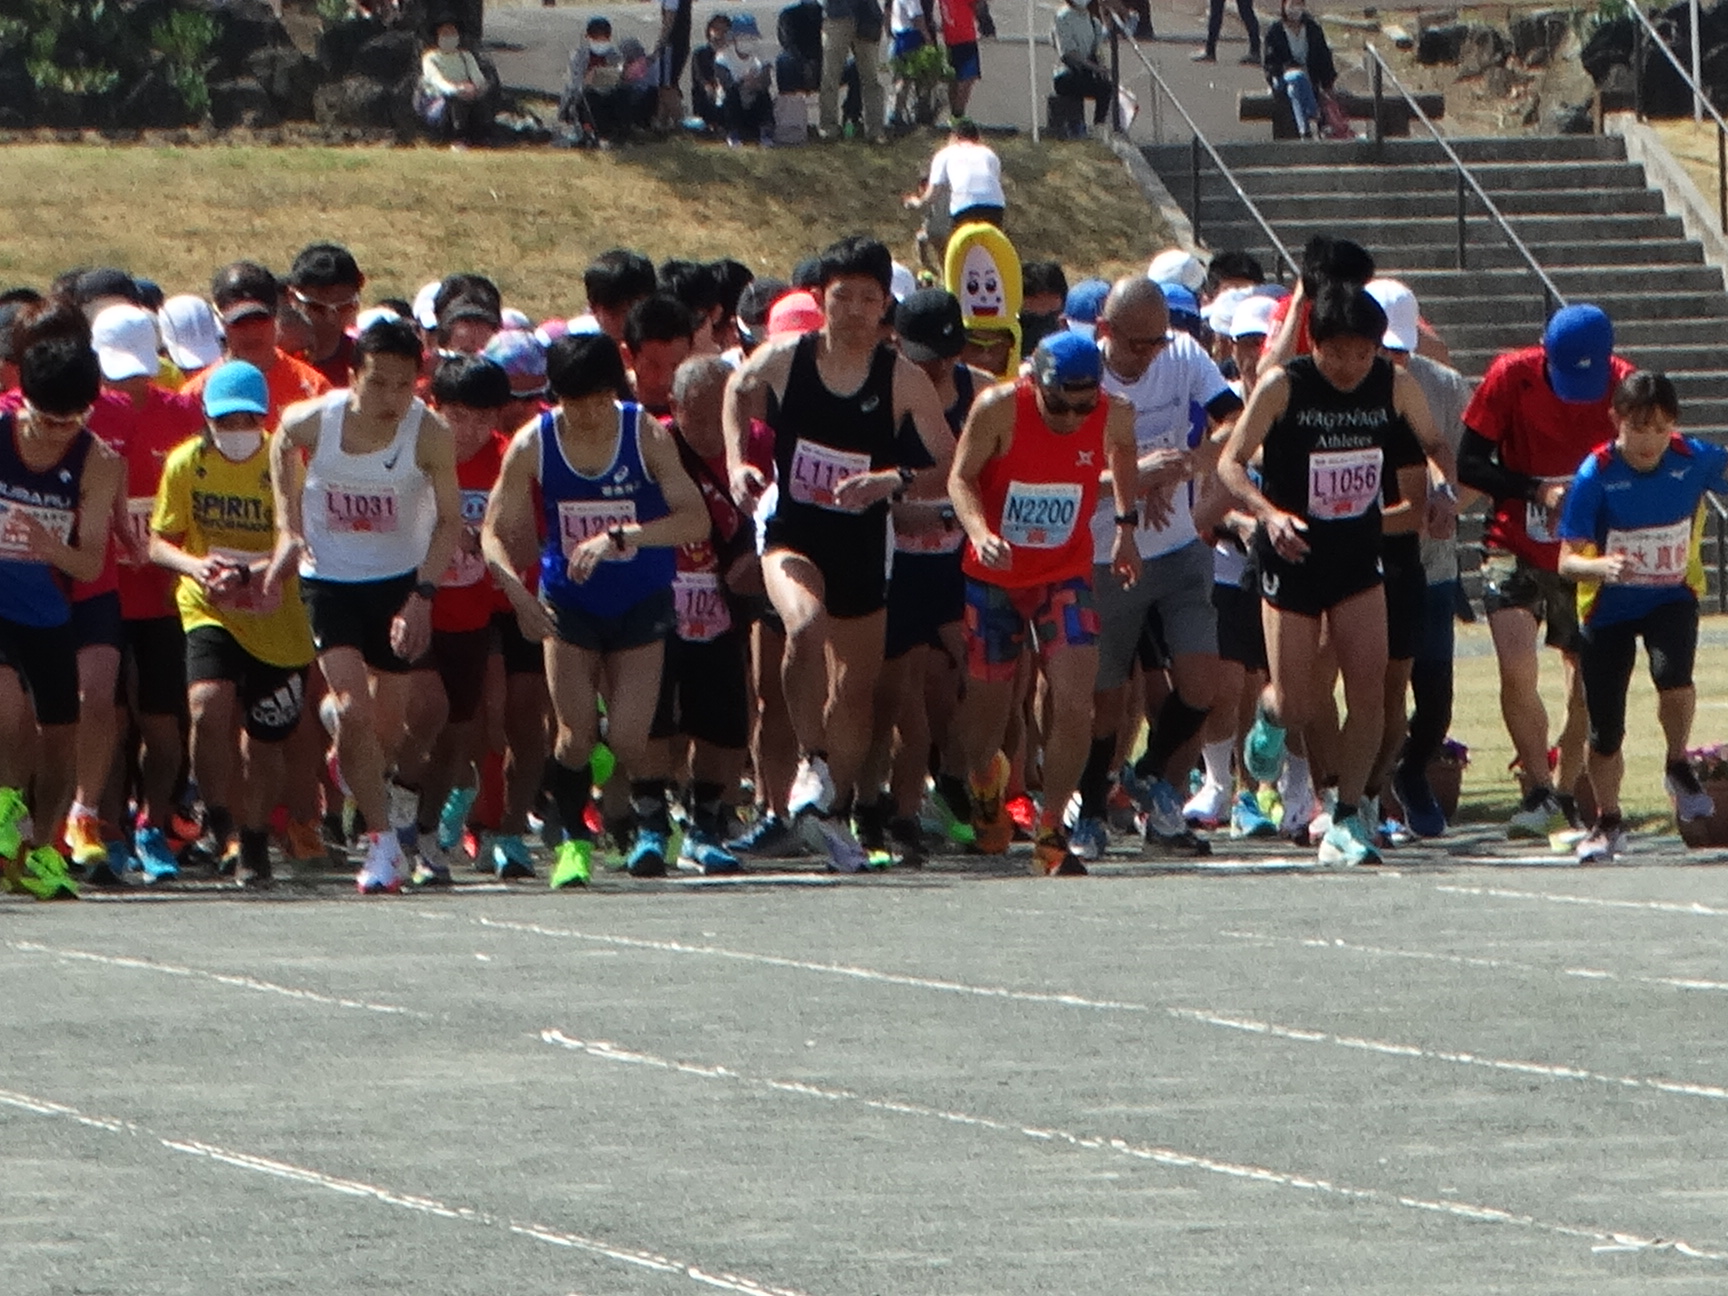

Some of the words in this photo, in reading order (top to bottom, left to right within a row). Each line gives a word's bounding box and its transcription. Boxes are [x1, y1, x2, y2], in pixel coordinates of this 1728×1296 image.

[1315, 433, 1373, 448] Athletes
[1313, 465, 1377, 497] L1056
[192, 490, 262, 521] SPIRIT
[1008, 496, 1075, 525] N2200
